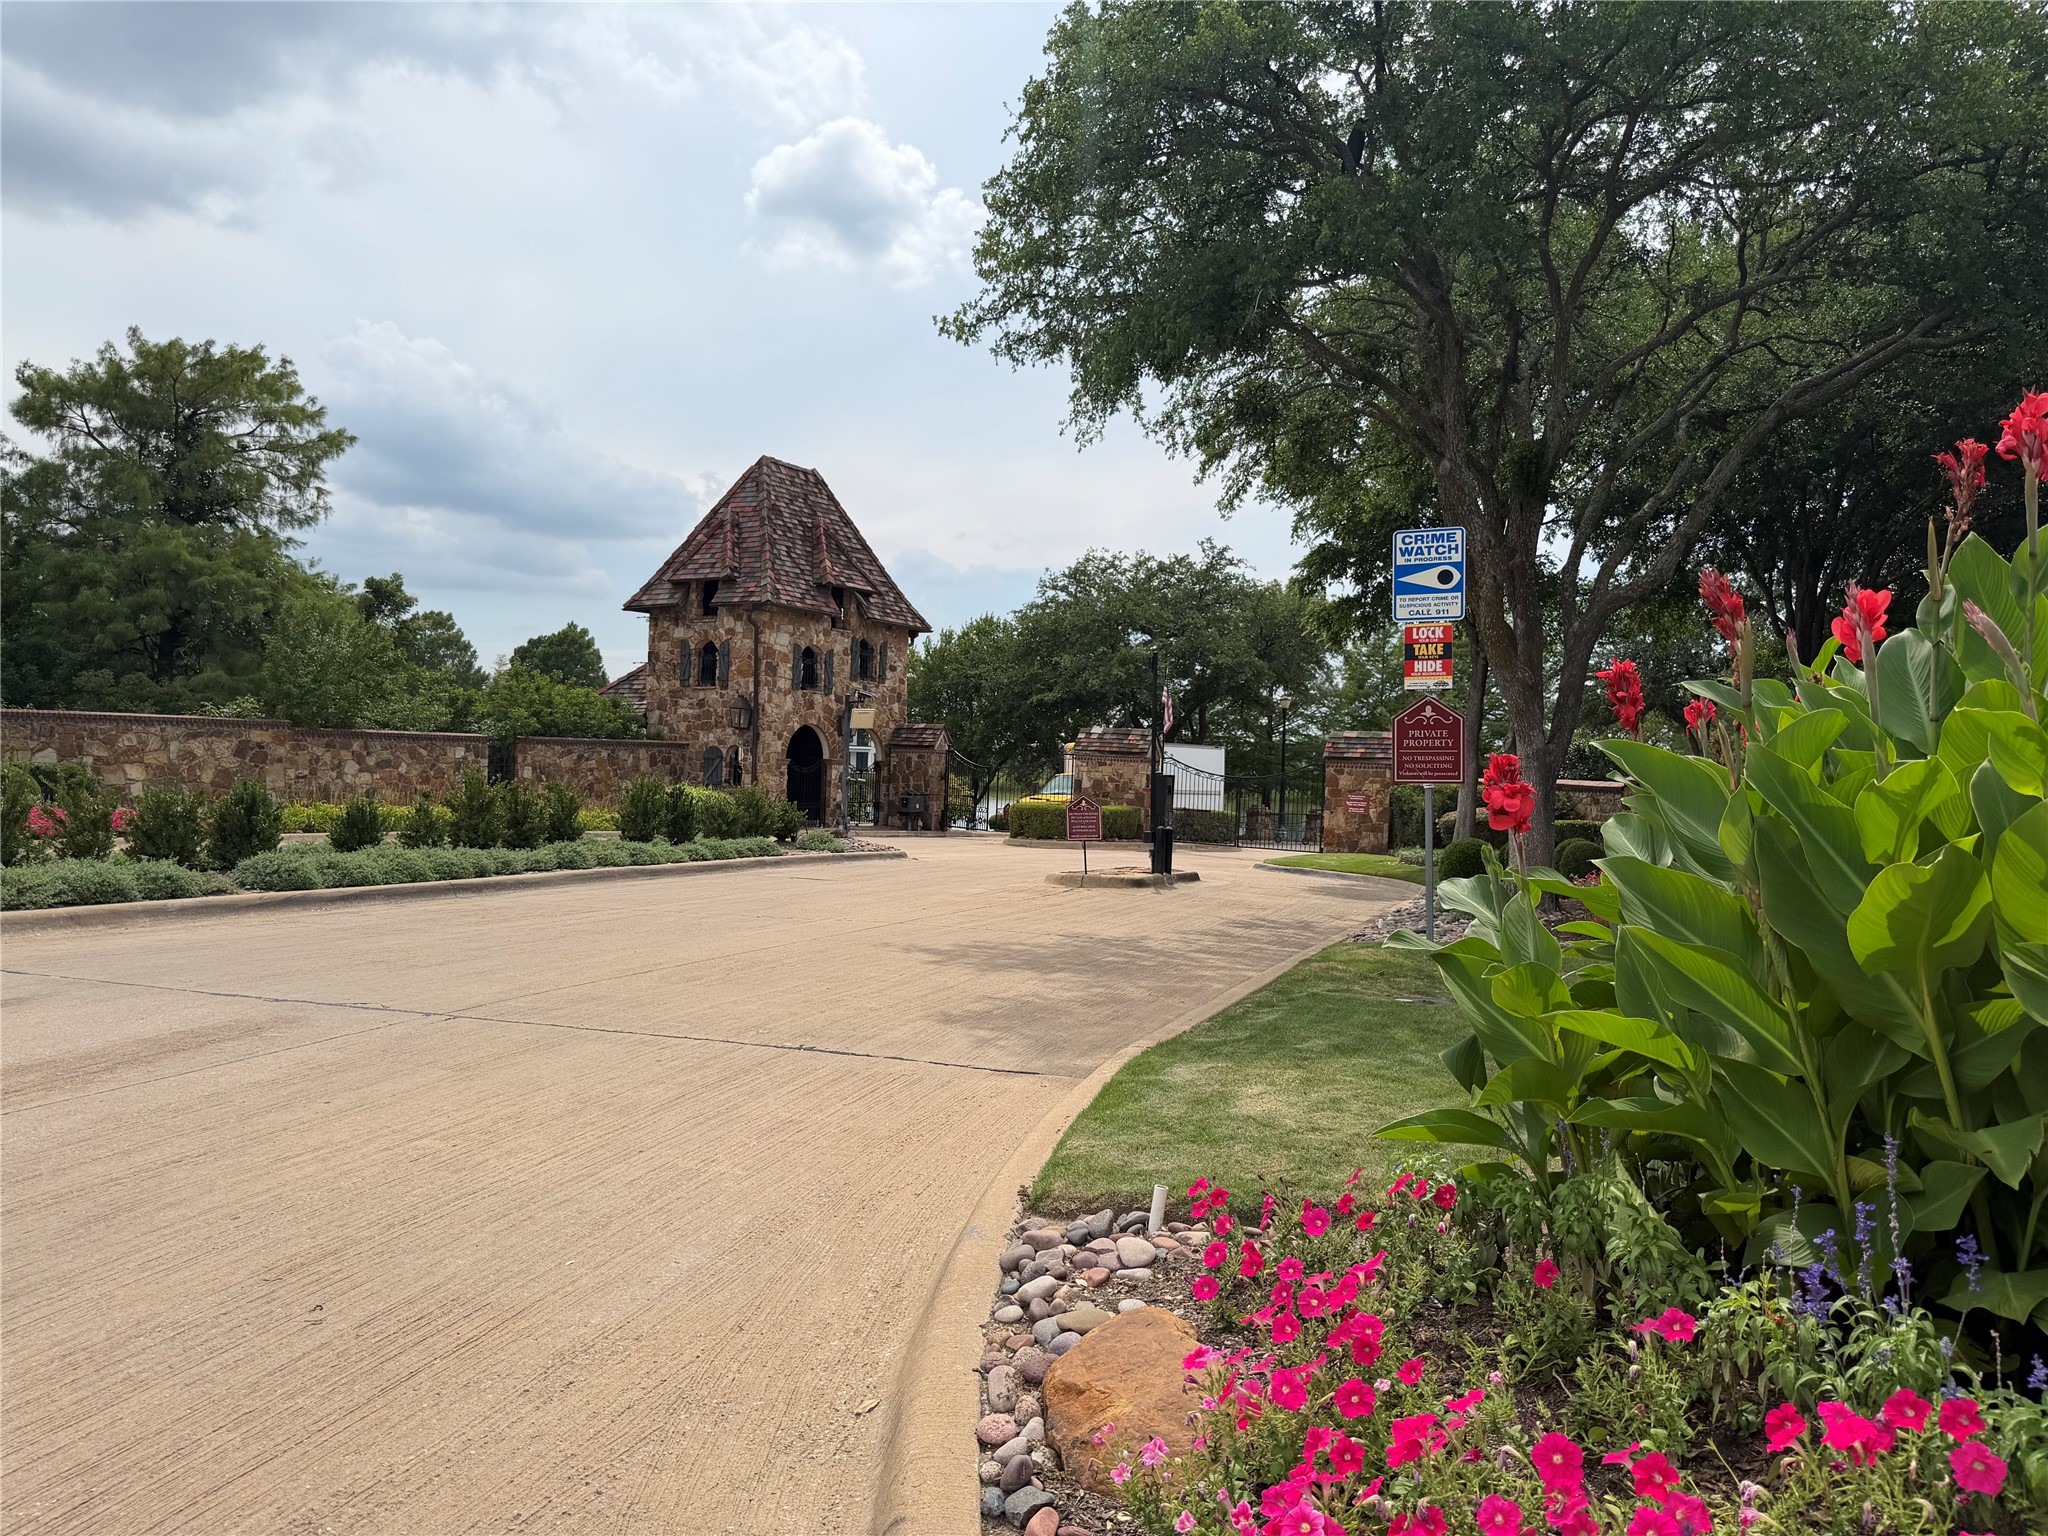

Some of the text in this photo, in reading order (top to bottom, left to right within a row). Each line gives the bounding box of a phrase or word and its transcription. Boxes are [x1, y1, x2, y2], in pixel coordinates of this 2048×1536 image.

[1401, 532, 1457, 546] CRIME
[1399, 543, 1459, 557] WATCH
[1412, 627, 1444, 639] LOCK
[1413, 643, 1444, 655] TAKE
[1414, 660, 1443, 672] HIDE
